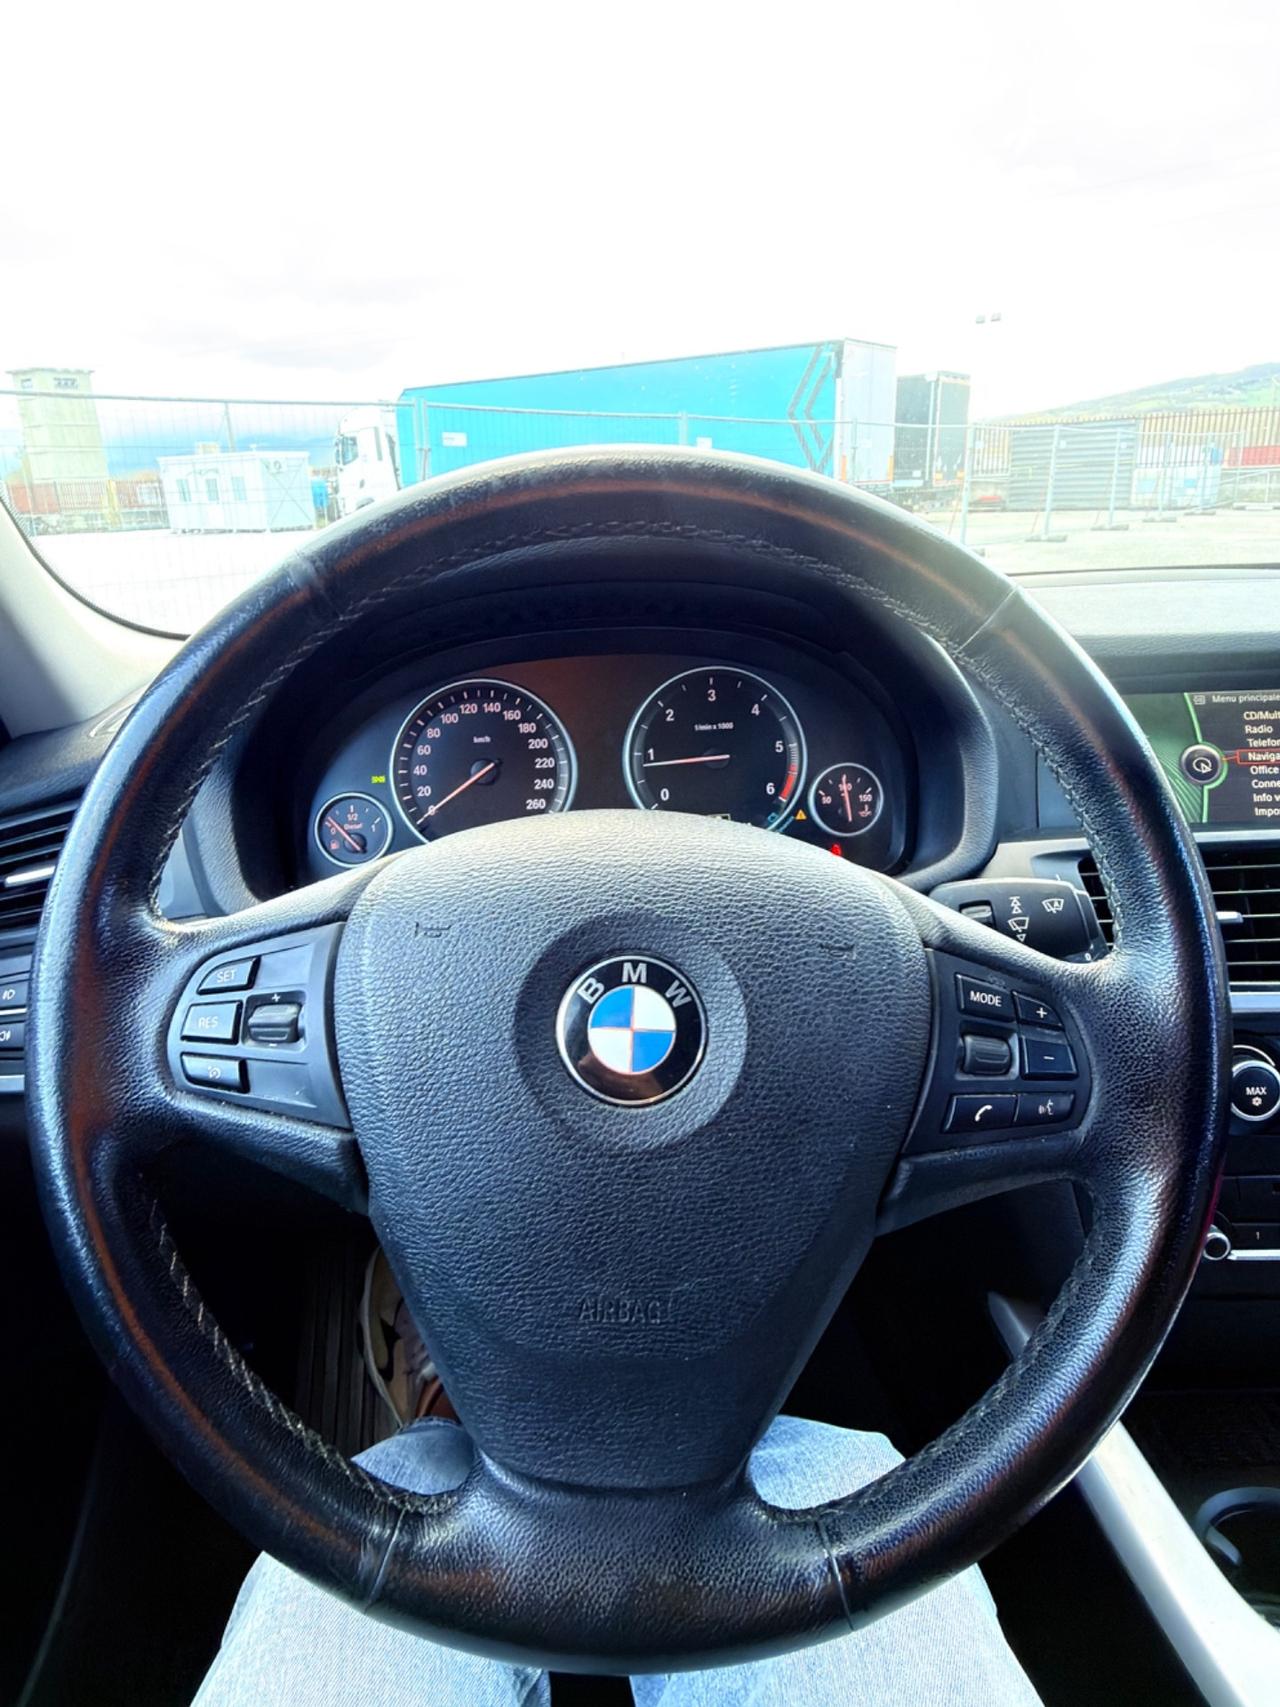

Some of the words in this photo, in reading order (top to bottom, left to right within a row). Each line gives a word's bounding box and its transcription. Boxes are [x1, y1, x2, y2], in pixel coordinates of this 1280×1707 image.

[707, 689, 717, 702] 3
[1212, 695, 1237, 703] Menu
[459, 703, 478, 714] 120
[483, 702, 501, 713] 140
[751, 704, 761, 716] 4
[440, 713, 459, 724] 100
[503, 709, 521, 721] 160
[665, 709, 676, 722] 2
[427, 728, 441, 739] 80
[518, 722, 537, 734] 180
[1245, 724, 1273, 734] Radio
[528, 738, 549, 749] 200
[775, 740, 784, 753] 5
[417, 745, 431, 756] 60
[648, 748, 654, 760] 1
[535, 757, 555, 768] 220
[413, 765, 428, 776] 40
[1250, 765, 1279, 775] Office
[534, 779, 554, 790] 240
[766, 782, 776, 795] 6
[417, 786, 432, 797] 20
[660, 788, 670, 801] 0
[1253, 793, 1273, 802] Info
[526, 798, 546, 810] 260
[216, 970, 236, 984] SET
[577, 962, 692, 1008] BMW
[970, 991, 1002, 1007] MODE
[198, 1016, 219, 1029] RES
[1246, 1086, 1267, 1096] MAX
[579, 1298, 661, 1323] AIRBAG
